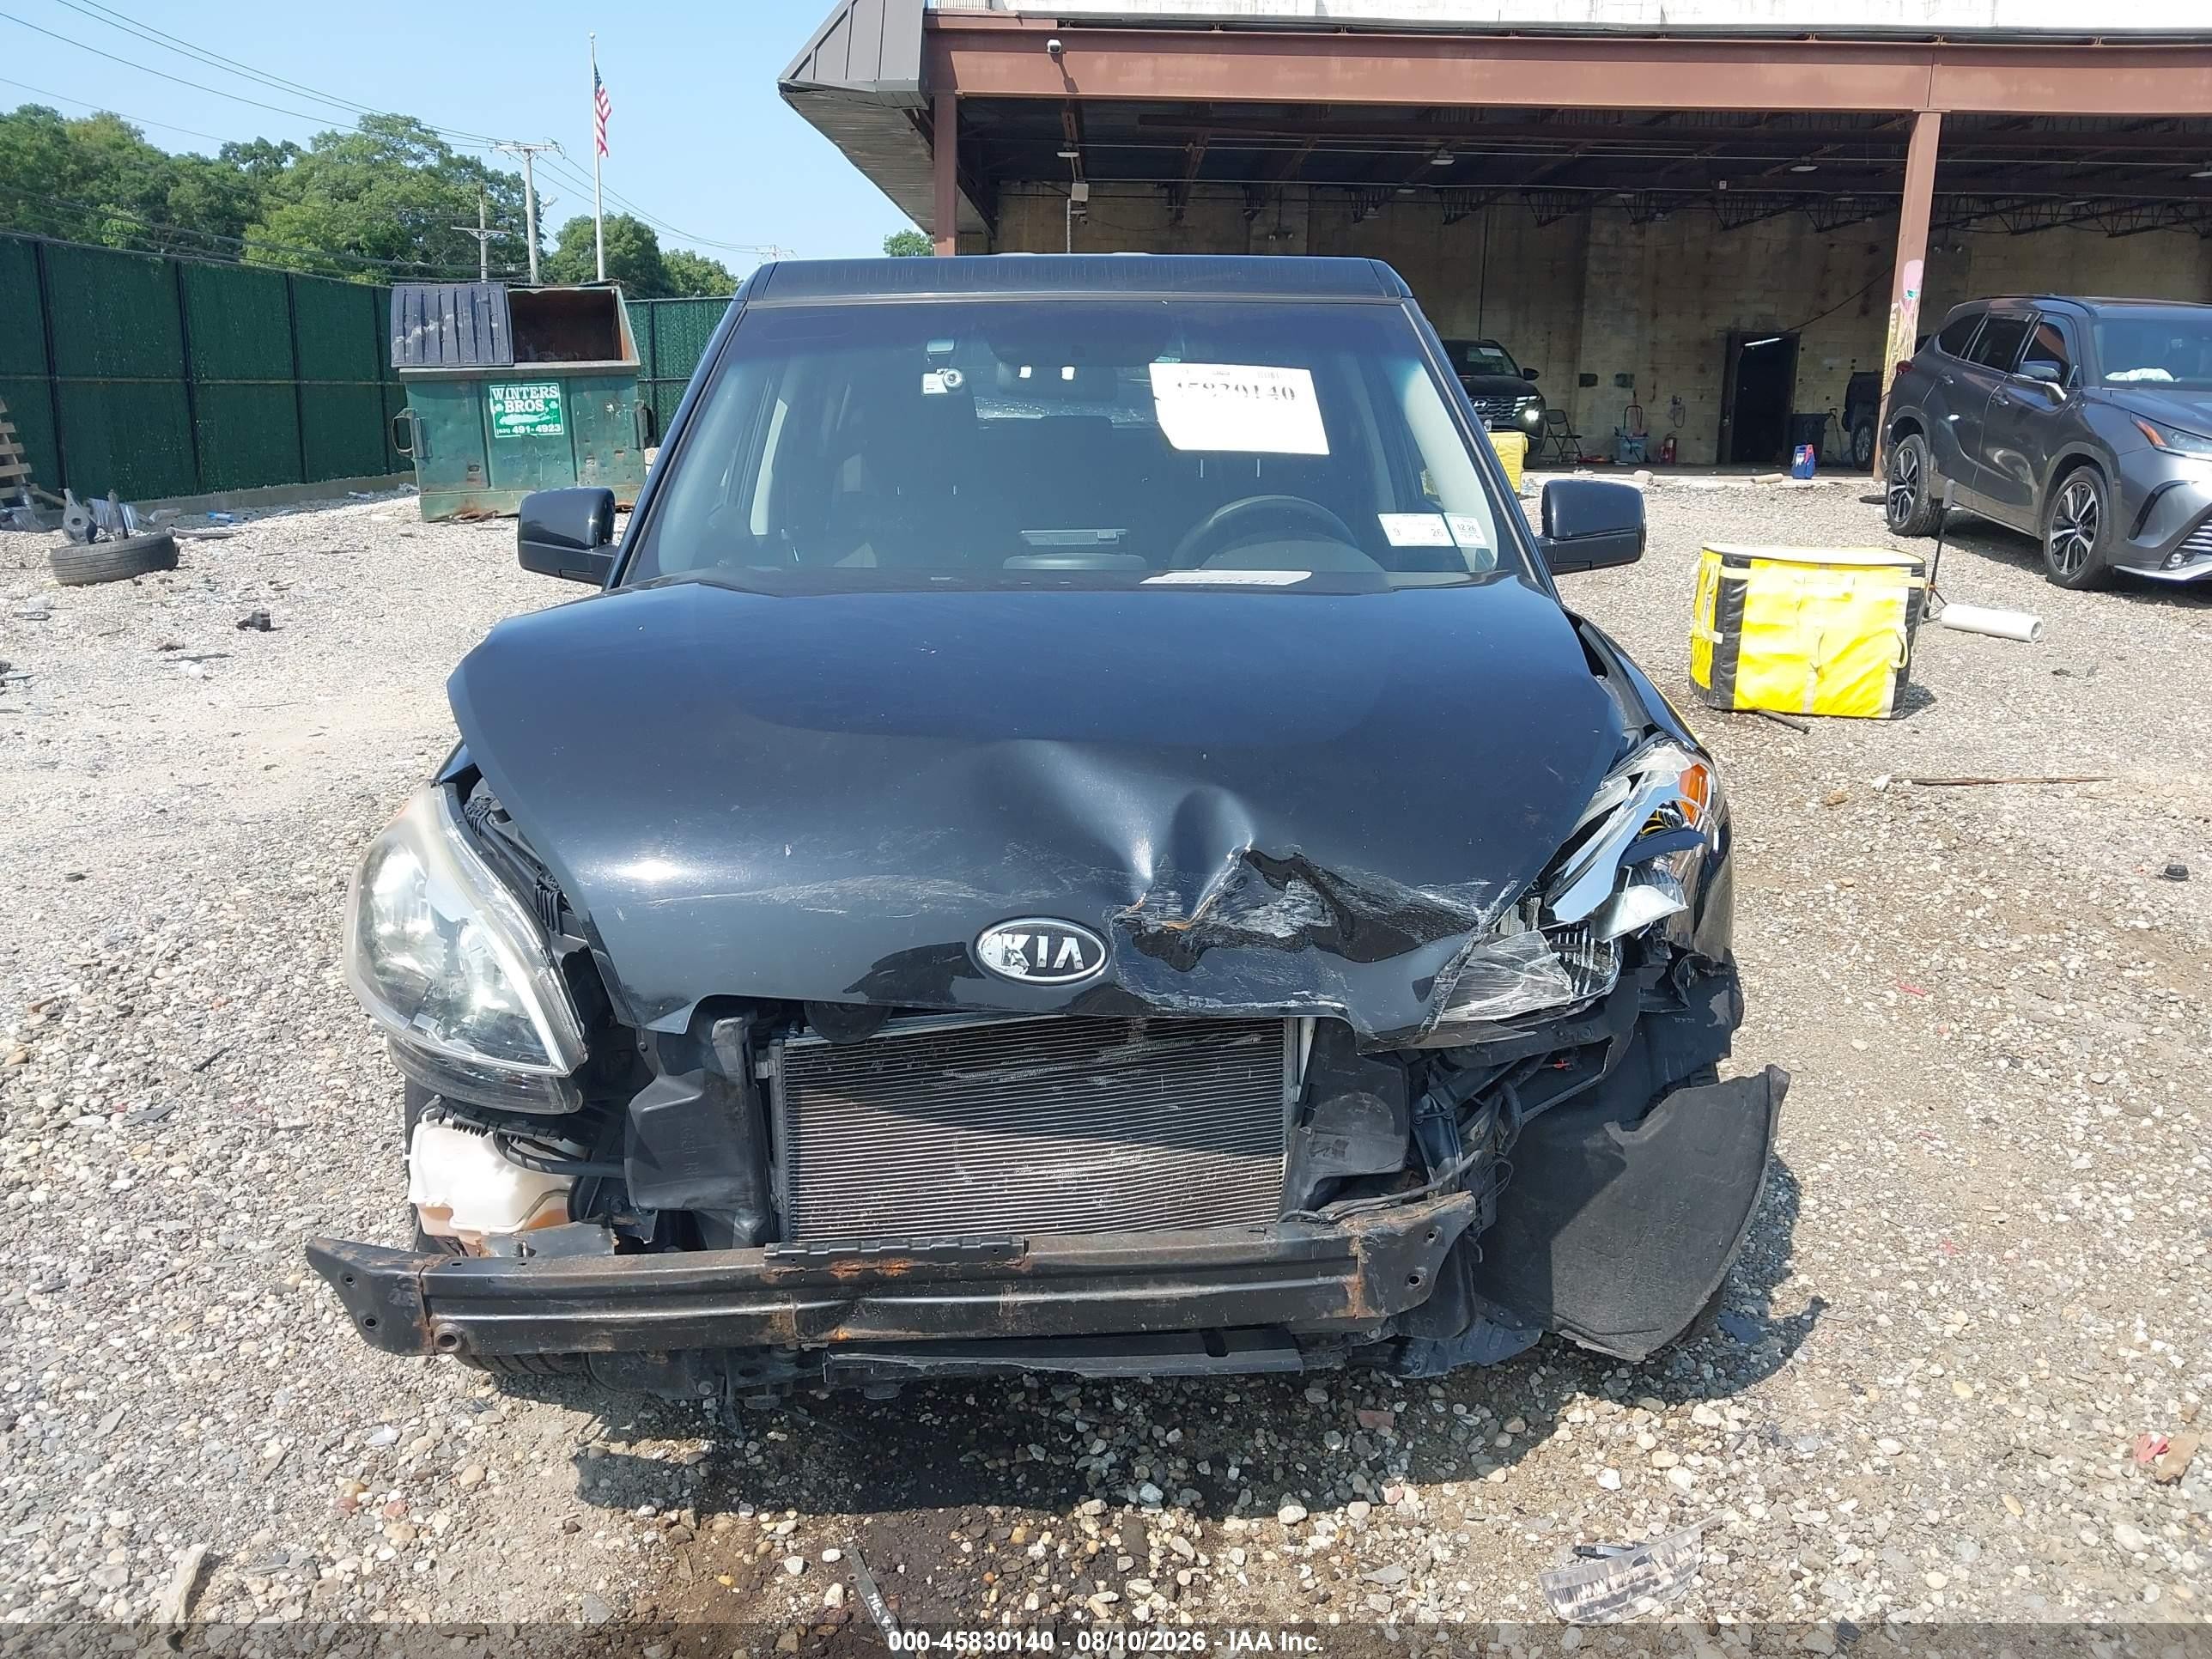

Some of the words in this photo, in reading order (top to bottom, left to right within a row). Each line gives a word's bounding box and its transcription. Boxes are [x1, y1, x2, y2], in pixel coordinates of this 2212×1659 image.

[492, 386, 559, 400] WINTERS
[504, 398, 550, 413] BROS.
[512, 424, 561, 434] 491-4923
[1000, 933, 1085, 969] KIA
